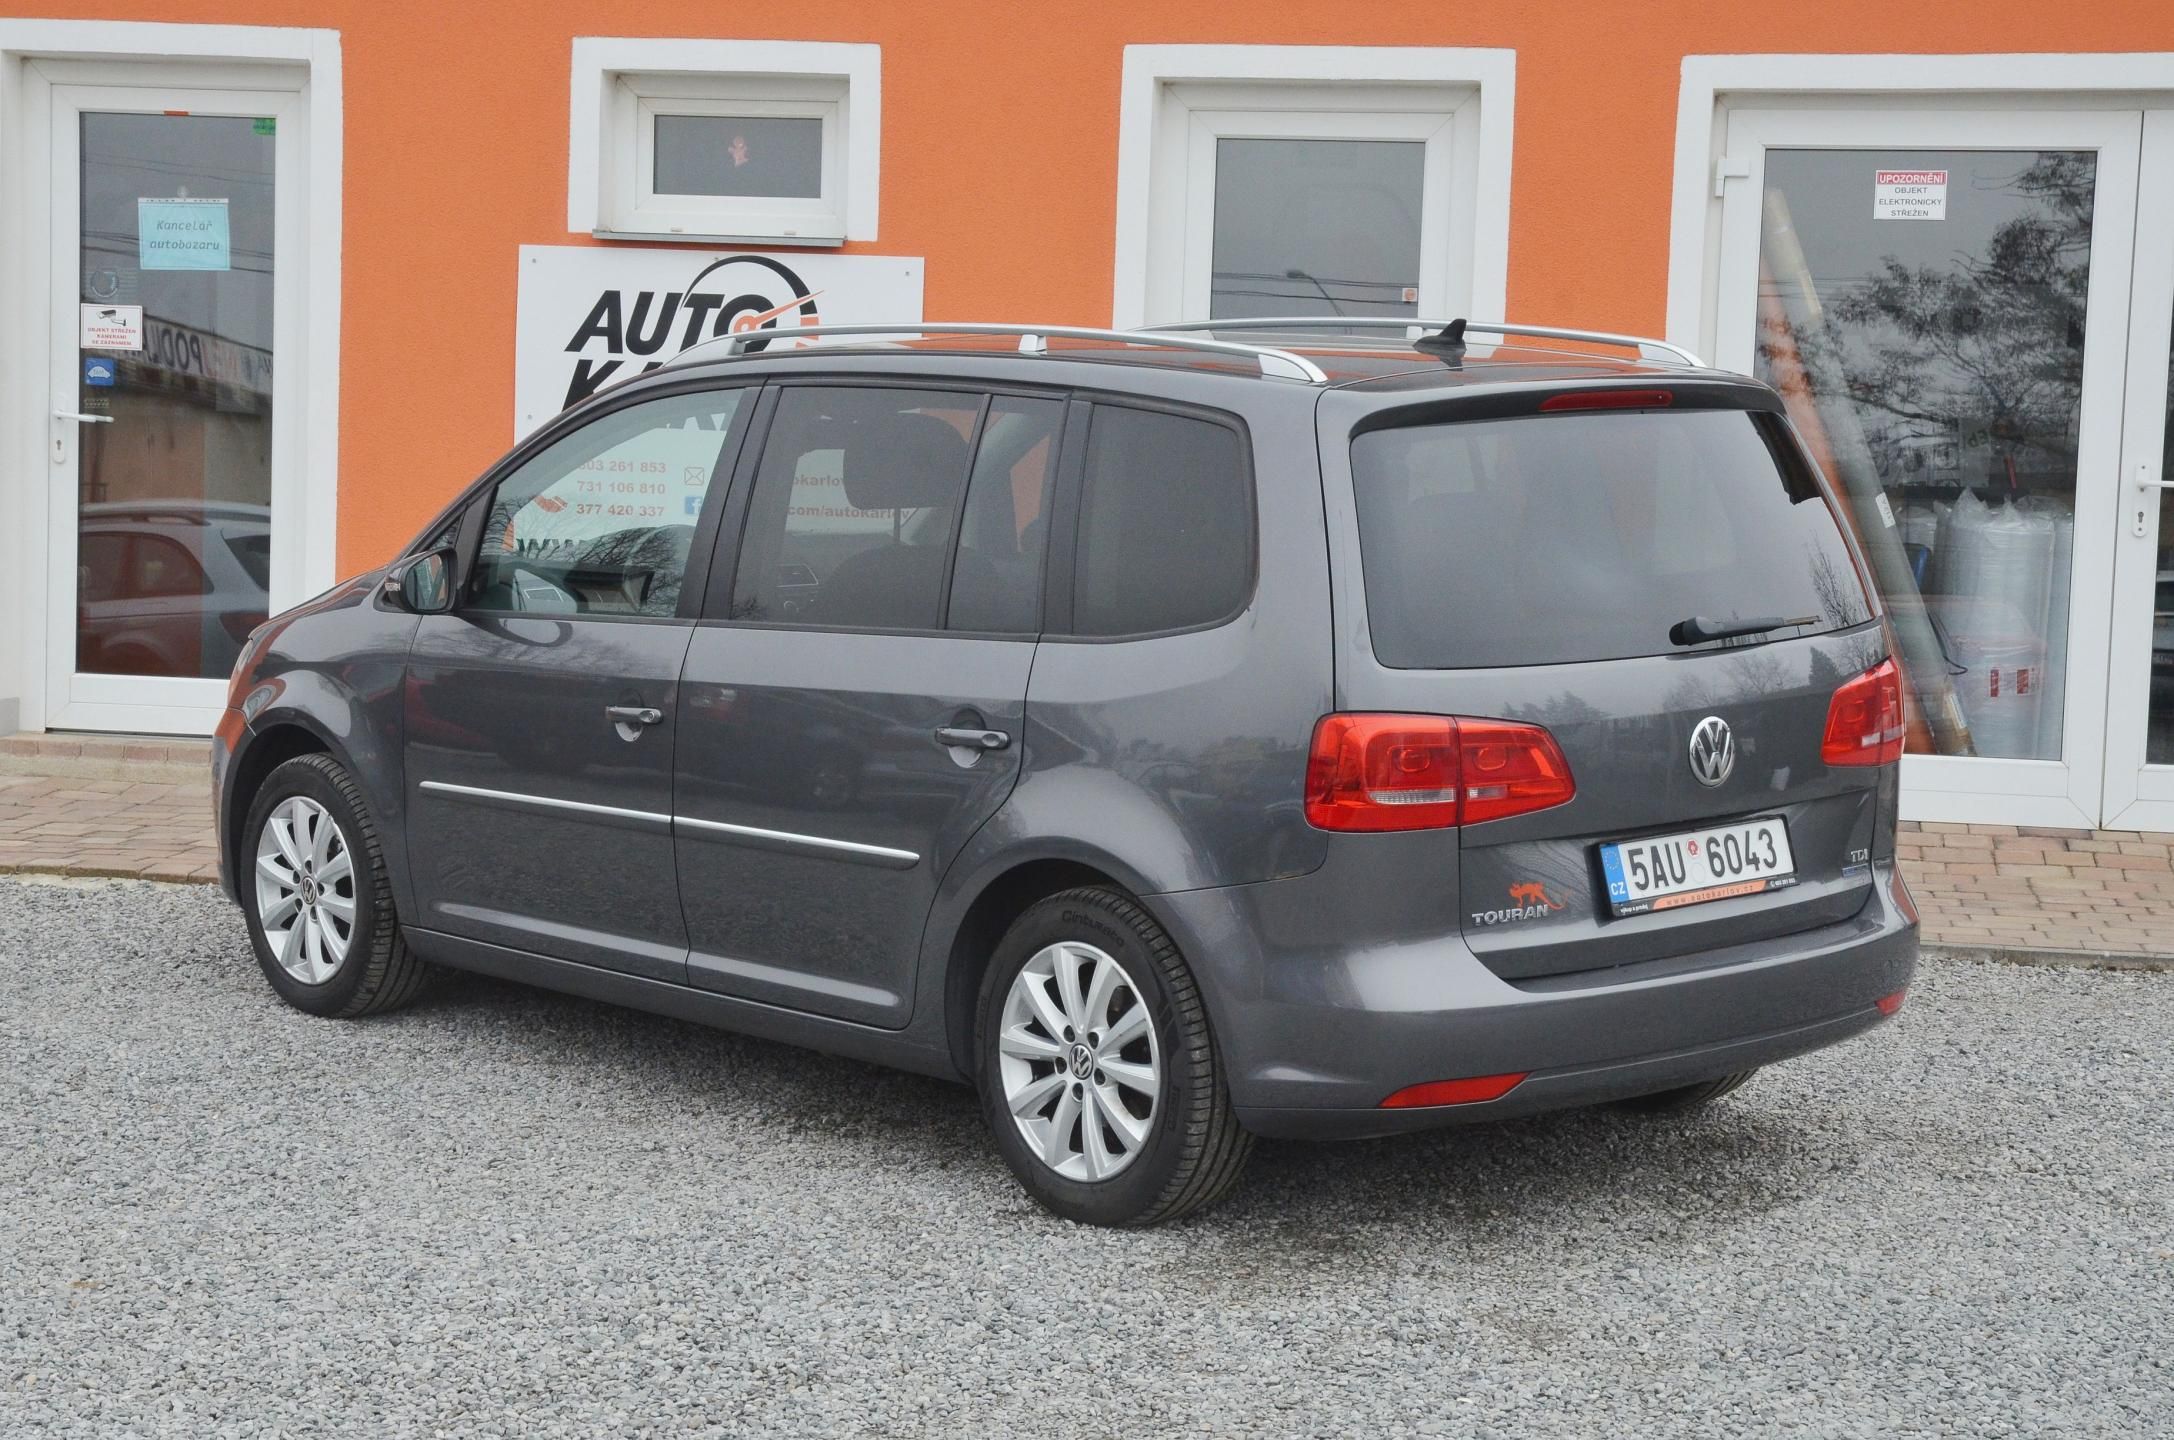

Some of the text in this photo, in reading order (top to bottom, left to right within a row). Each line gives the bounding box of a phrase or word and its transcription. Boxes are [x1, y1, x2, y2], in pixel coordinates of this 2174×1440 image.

[1879, 172, 1944, 184] UPOZORNĚNÍ
[1878, 198, 1942, 206] ELEKTRONICKY
[1890, 208, 1929, 217] STŘEŽEN
[150, 239, 220, 250] autobazaru
[563, 289, 777, 355] AUTO
[608, 461, 634, 473] 261
[640, 462, 667, 474] 853
[577, 480, 666, 495] 731 106 810
[576, 503, 665, 517] 377 420 337
[1627, 828, 1778, 891] 5AU 6043
[1610, 881, 1626, 896] CZ
[1471, 904, 1549, 926] TOURAN
